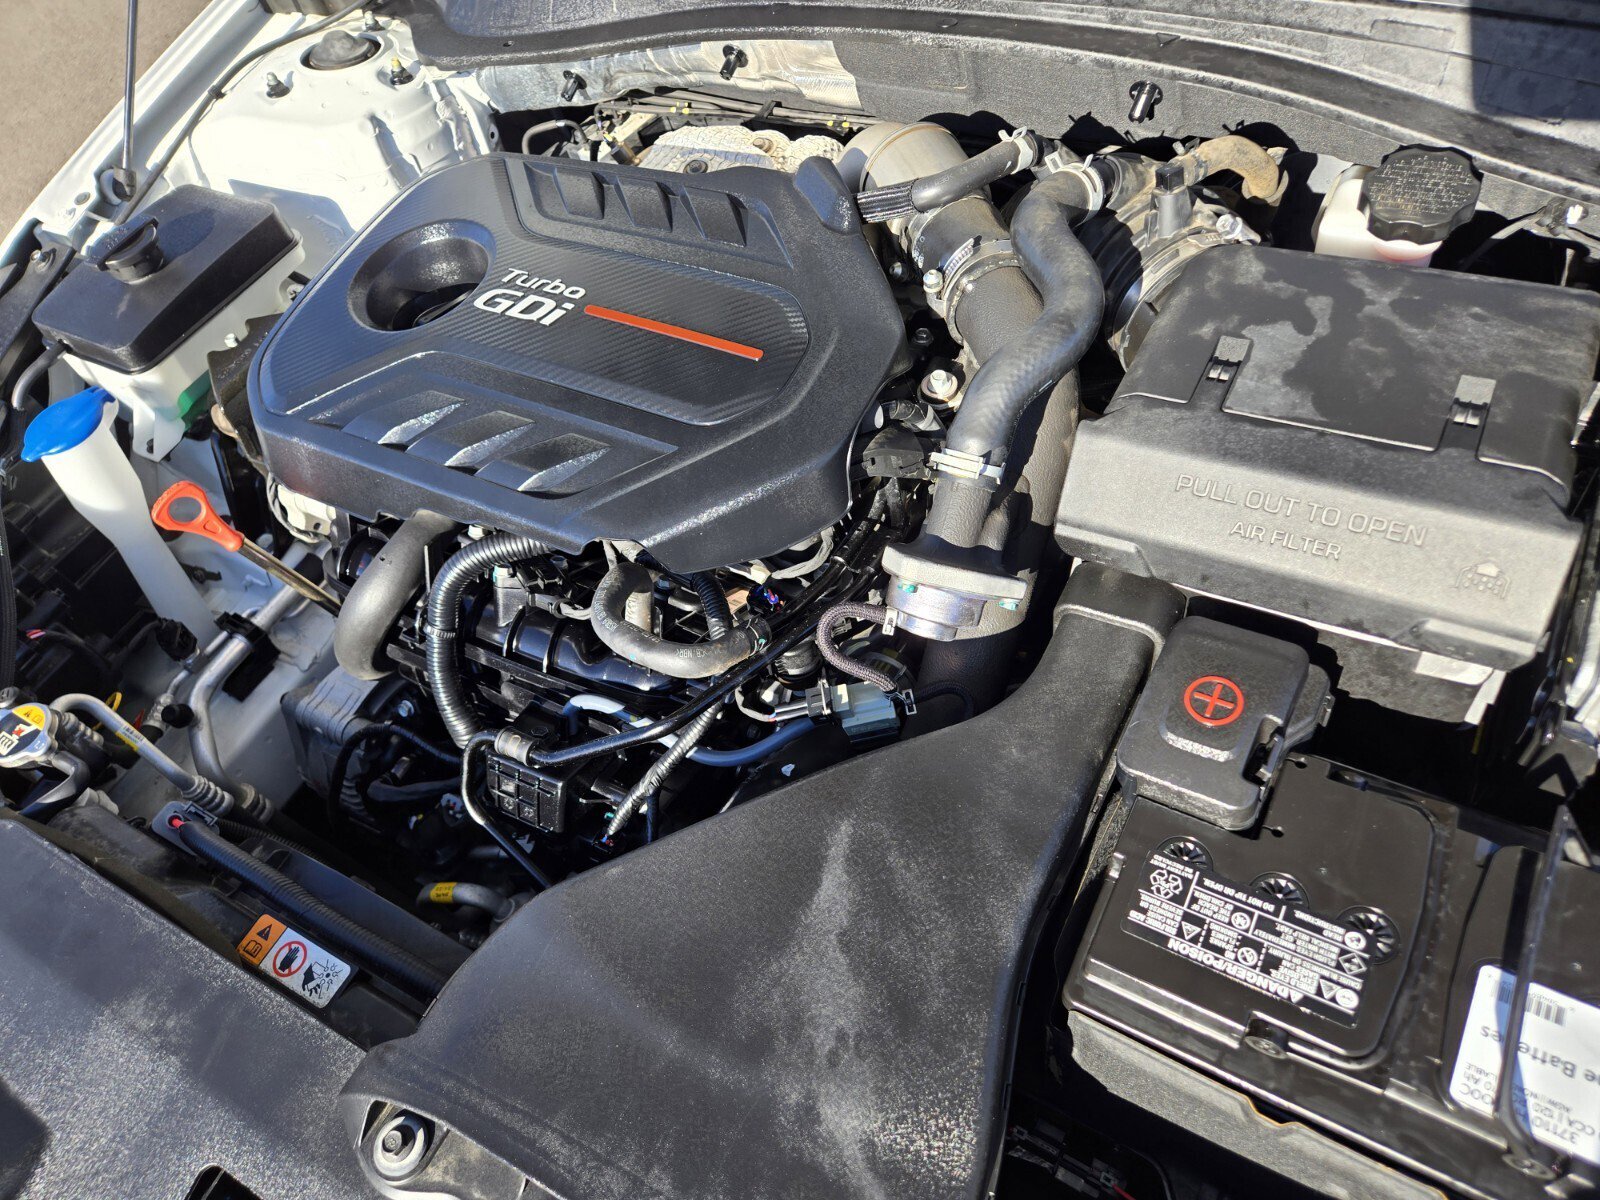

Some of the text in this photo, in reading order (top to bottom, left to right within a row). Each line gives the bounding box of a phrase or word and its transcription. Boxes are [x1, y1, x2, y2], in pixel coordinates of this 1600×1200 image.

[501, 267, 586, 299] Turbo
[473, 288, 575, 326] GDi
[1175, 474, 1428, 548] PULL OUT TO OPEN
[1229, 521, 1342, 560] AIR FILTER
[1222, 885, 1235, 896] OR
[1234, 890, 1247, 901] TIP
[1246, 895, 1263, 907] NOT
[1262, 901, 1275, 912] DO
[1167, 937, 1290, 998] DANGER/POISON
[1478, 1022, 1577, 1078] Battees
